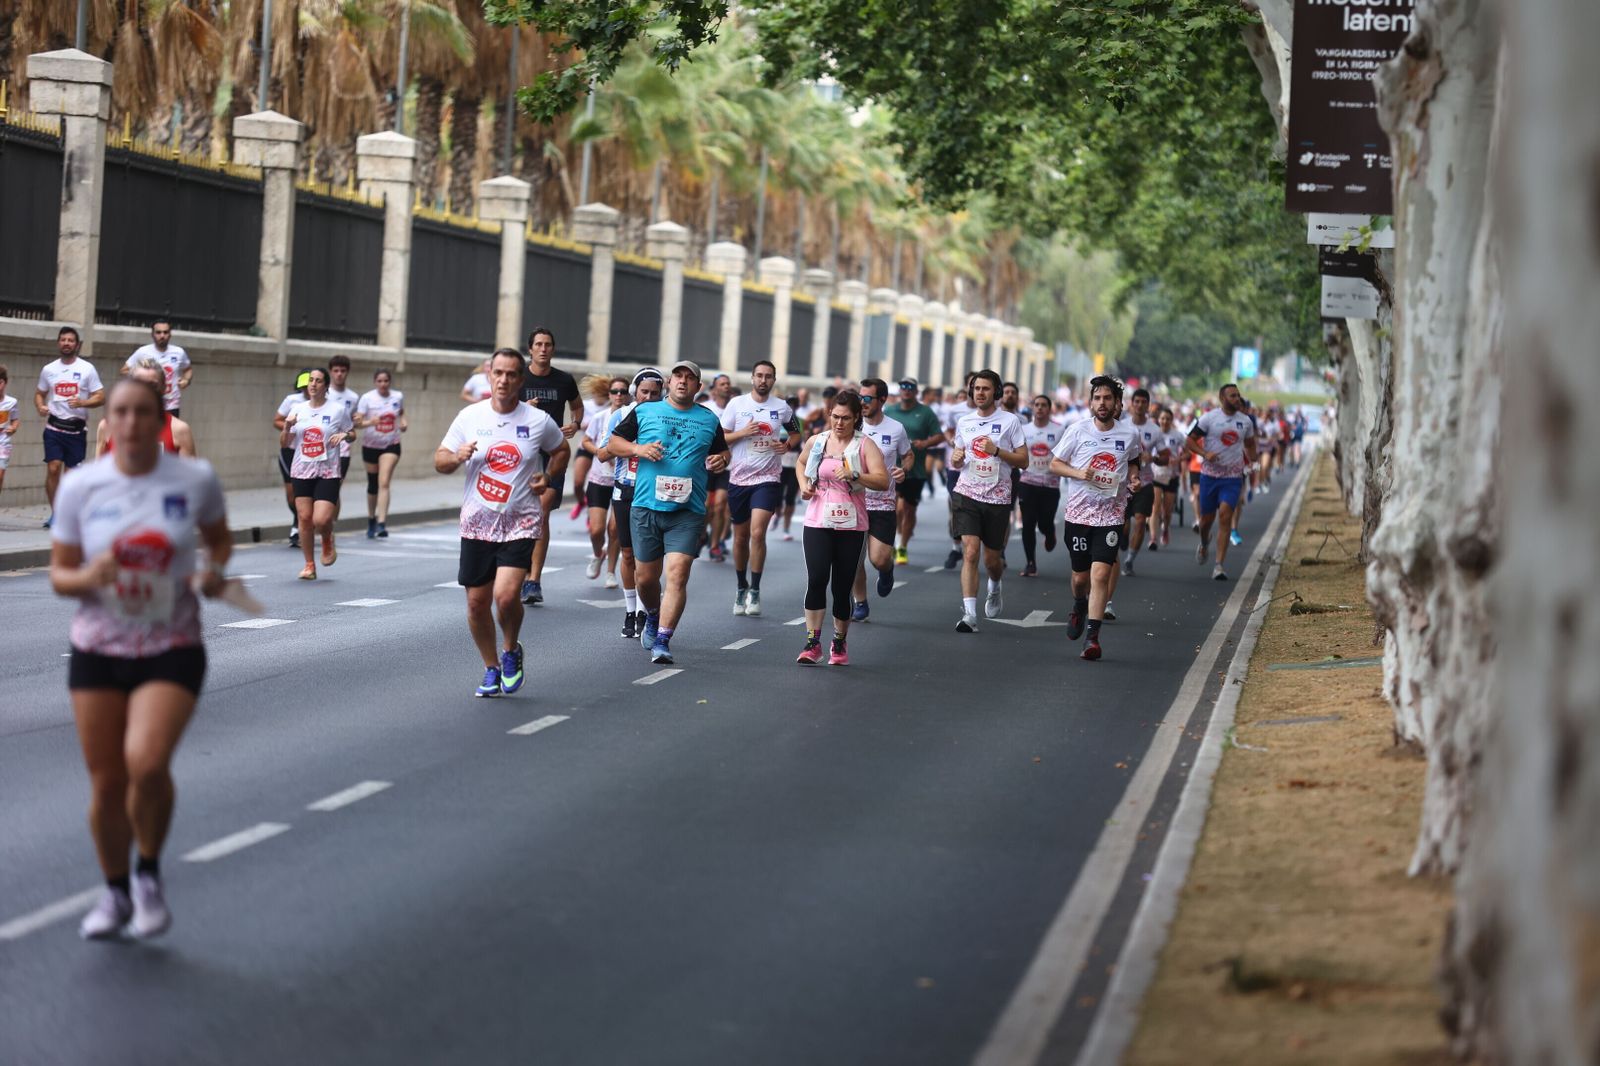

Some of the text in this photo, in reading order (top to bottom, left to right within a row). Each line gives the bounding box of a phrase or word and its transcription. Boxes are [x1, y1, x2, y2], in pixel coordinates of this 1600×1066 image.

[1337, 61, 1349, 69] LA
[1095, 475, 1112, 484] 903
[479, 480, 507, 499] 2677
[664, 483, 684, 491] 567
[1072, 536, 1088, 551] 26
